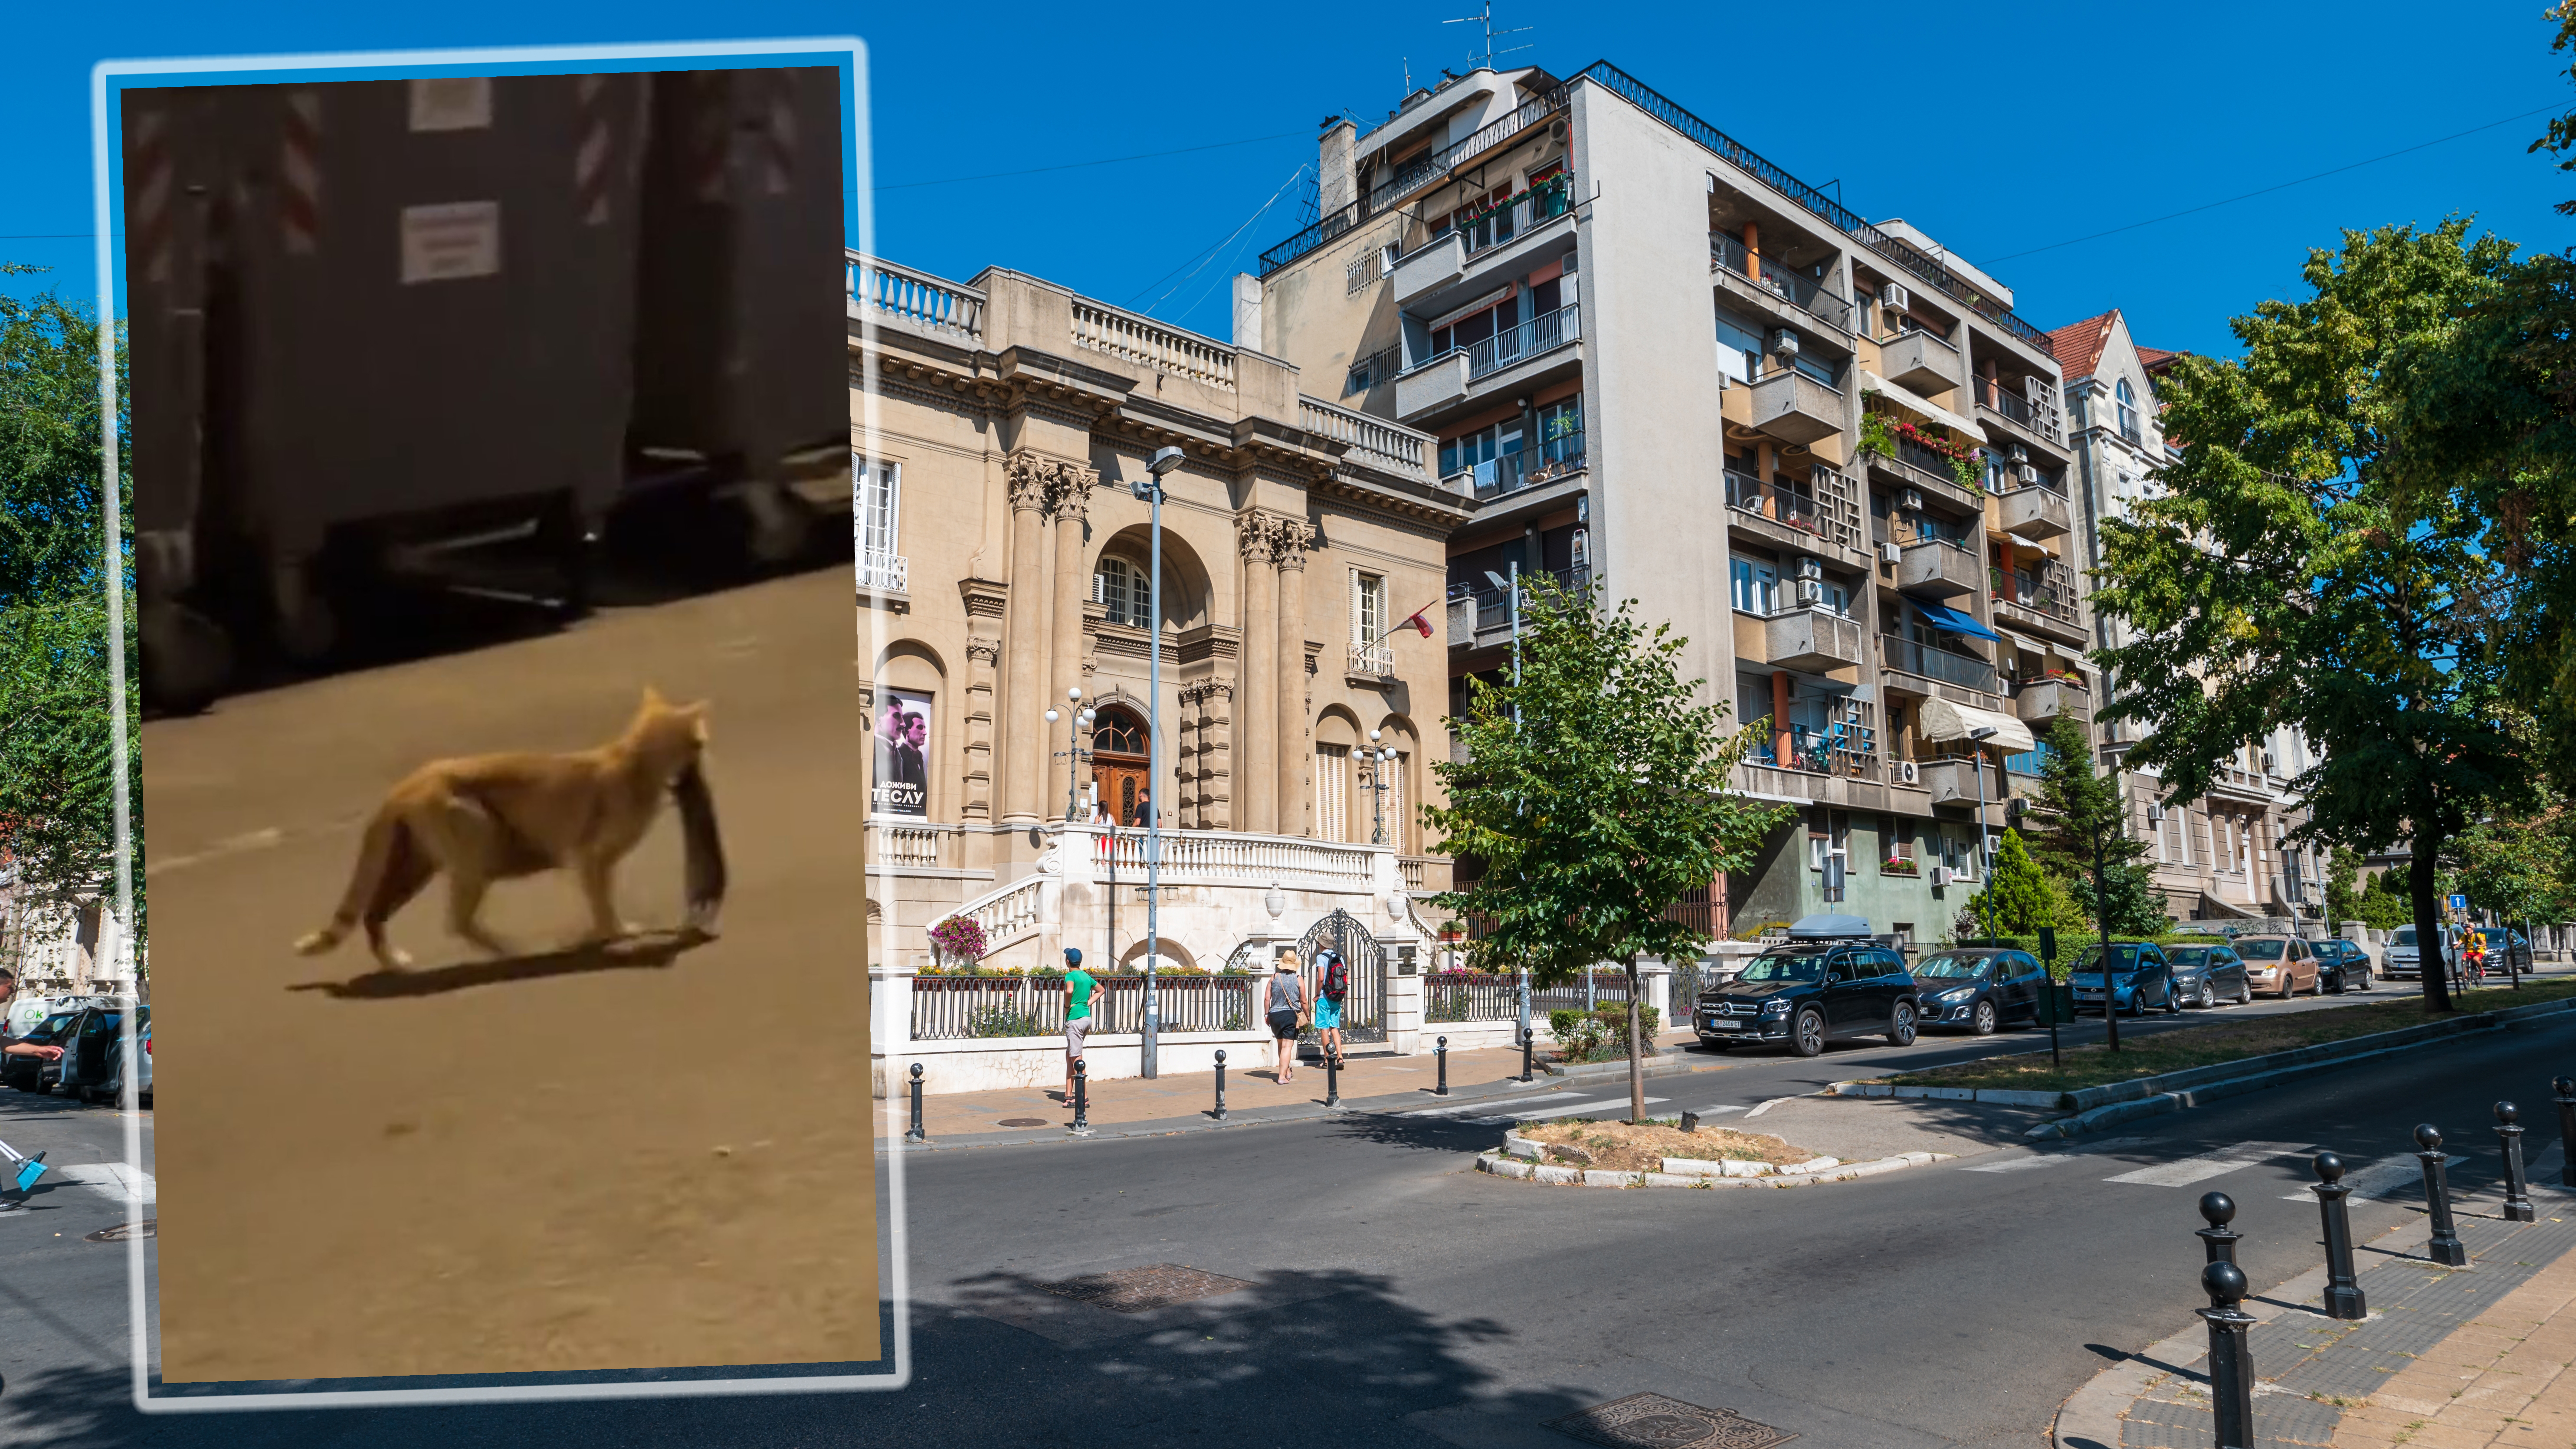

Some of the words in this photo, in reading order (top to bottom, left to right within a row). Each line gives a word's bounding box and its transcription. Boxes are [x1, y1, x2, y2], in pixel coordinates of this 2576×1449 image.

[880, 780, 917, 790] ДОЖИВИ
[872, 788, 924, 804] ТЕСЛУ
[24, 1009, 44, 1020] Ok
